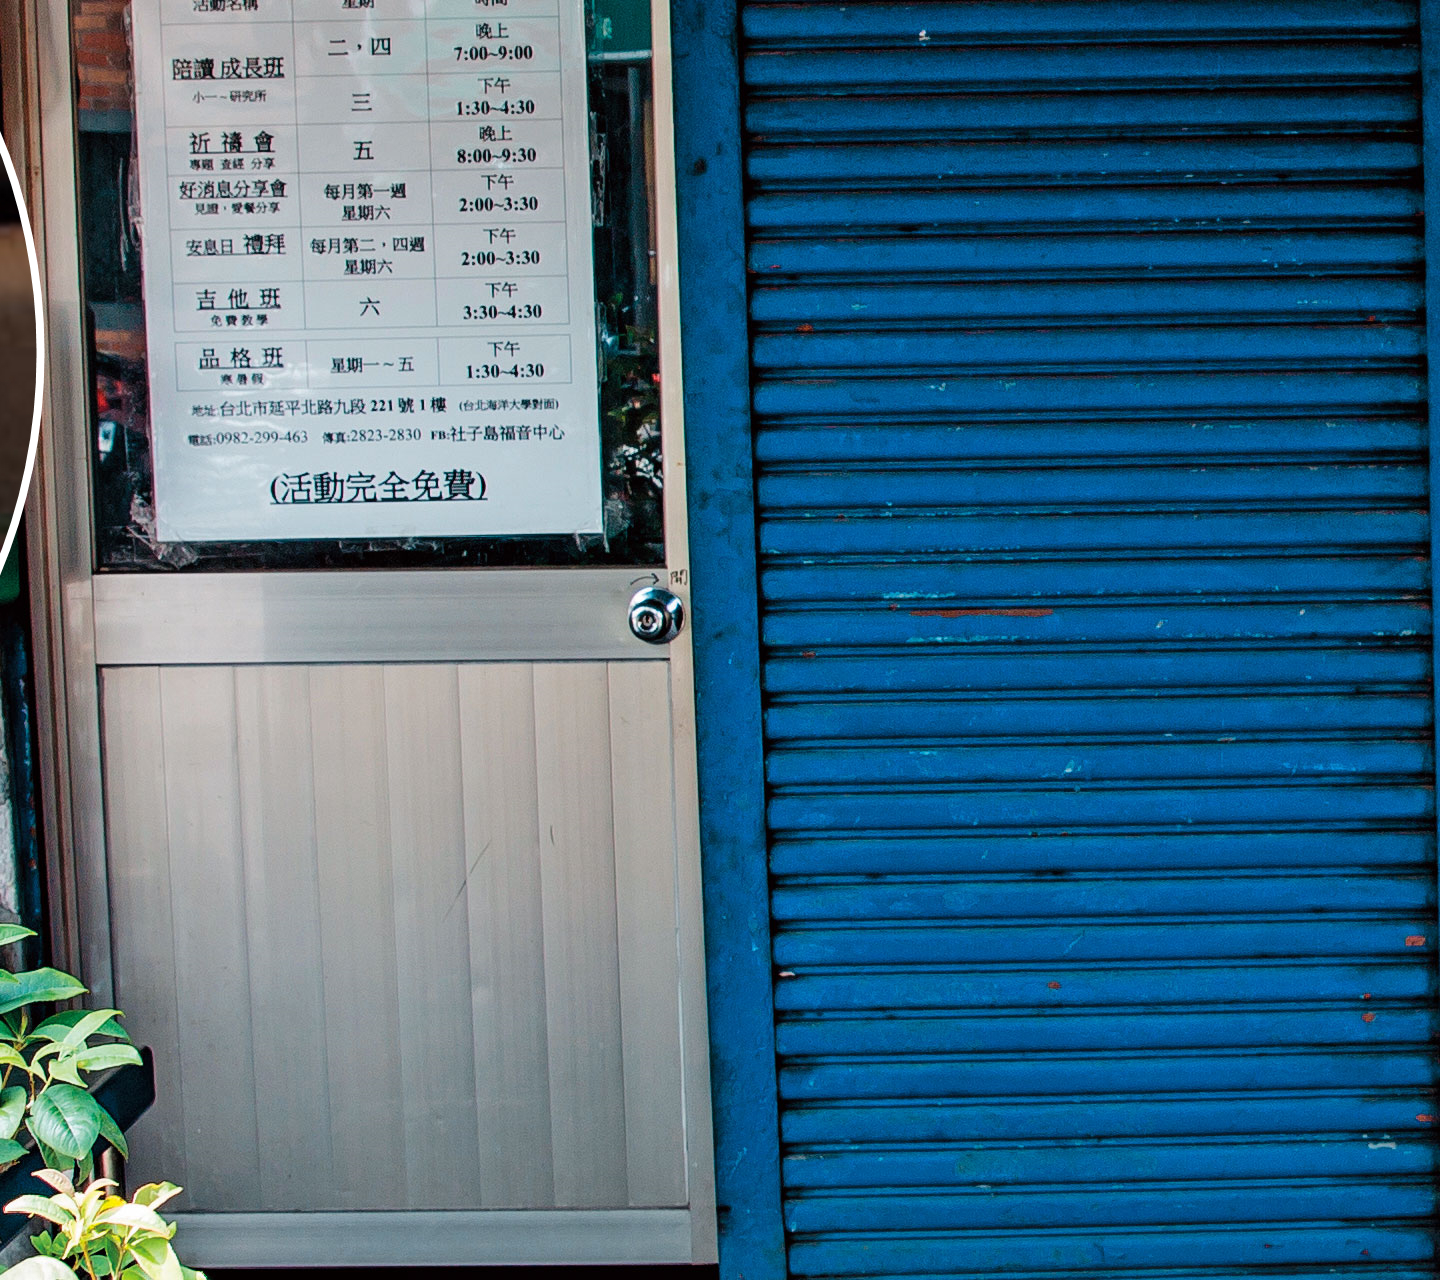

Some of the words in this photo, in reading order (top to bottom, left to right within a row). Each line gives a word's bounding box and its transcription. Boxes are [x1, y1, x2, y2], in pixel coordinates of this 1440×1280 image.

[475, 22, 508, 40] 晚上
[453, 44, 533, 63] 7:00~9:00
[171, 58, 217, 79] 陪讀
[220, 56, 285, 78] 成長班
[477, 77, 511, 94] 下午
[351, 94, 372, 113] 三
[456, 98, 535, 116] 1:30~4:30
[478, 125, 512, 143] 晚上
[352, 140, 374, 161] 五
[457, 146, 536, 164] 8:00~9:30
[179, 177, 287, 200] 好消息分享會
[480, 173, 514, 190] 下午
[324, 182, 406, 202] 每月第一週
[341, 203, 391, 221] 星期六
[458, 195, 538, 213] 2:00~3:30
[482, 227, 515, 244] 下午
[185, 237, 234, 256] 安息日
[243, 234, 286, 255] 禮拜
[344, 258, 393, 276] 星期六
[461, 249, 540, 267] 2:00~3:30
[485, 280, 519, 297] 下午
[359, 296, 381, 317] 六
[462, 302, 542, 320] 3:30~4:30
[487, 341, 520, 358] 下午
[465, 361, 544, 379] 1:30~4:30
[371, 400, 393, 412] 221
[398, 399, 414, 413] 號
[420, 399, 425, 411] 1
[431, 397, 446, 413] 樓
[270, 469, 488, 504] (活動完全免費)
